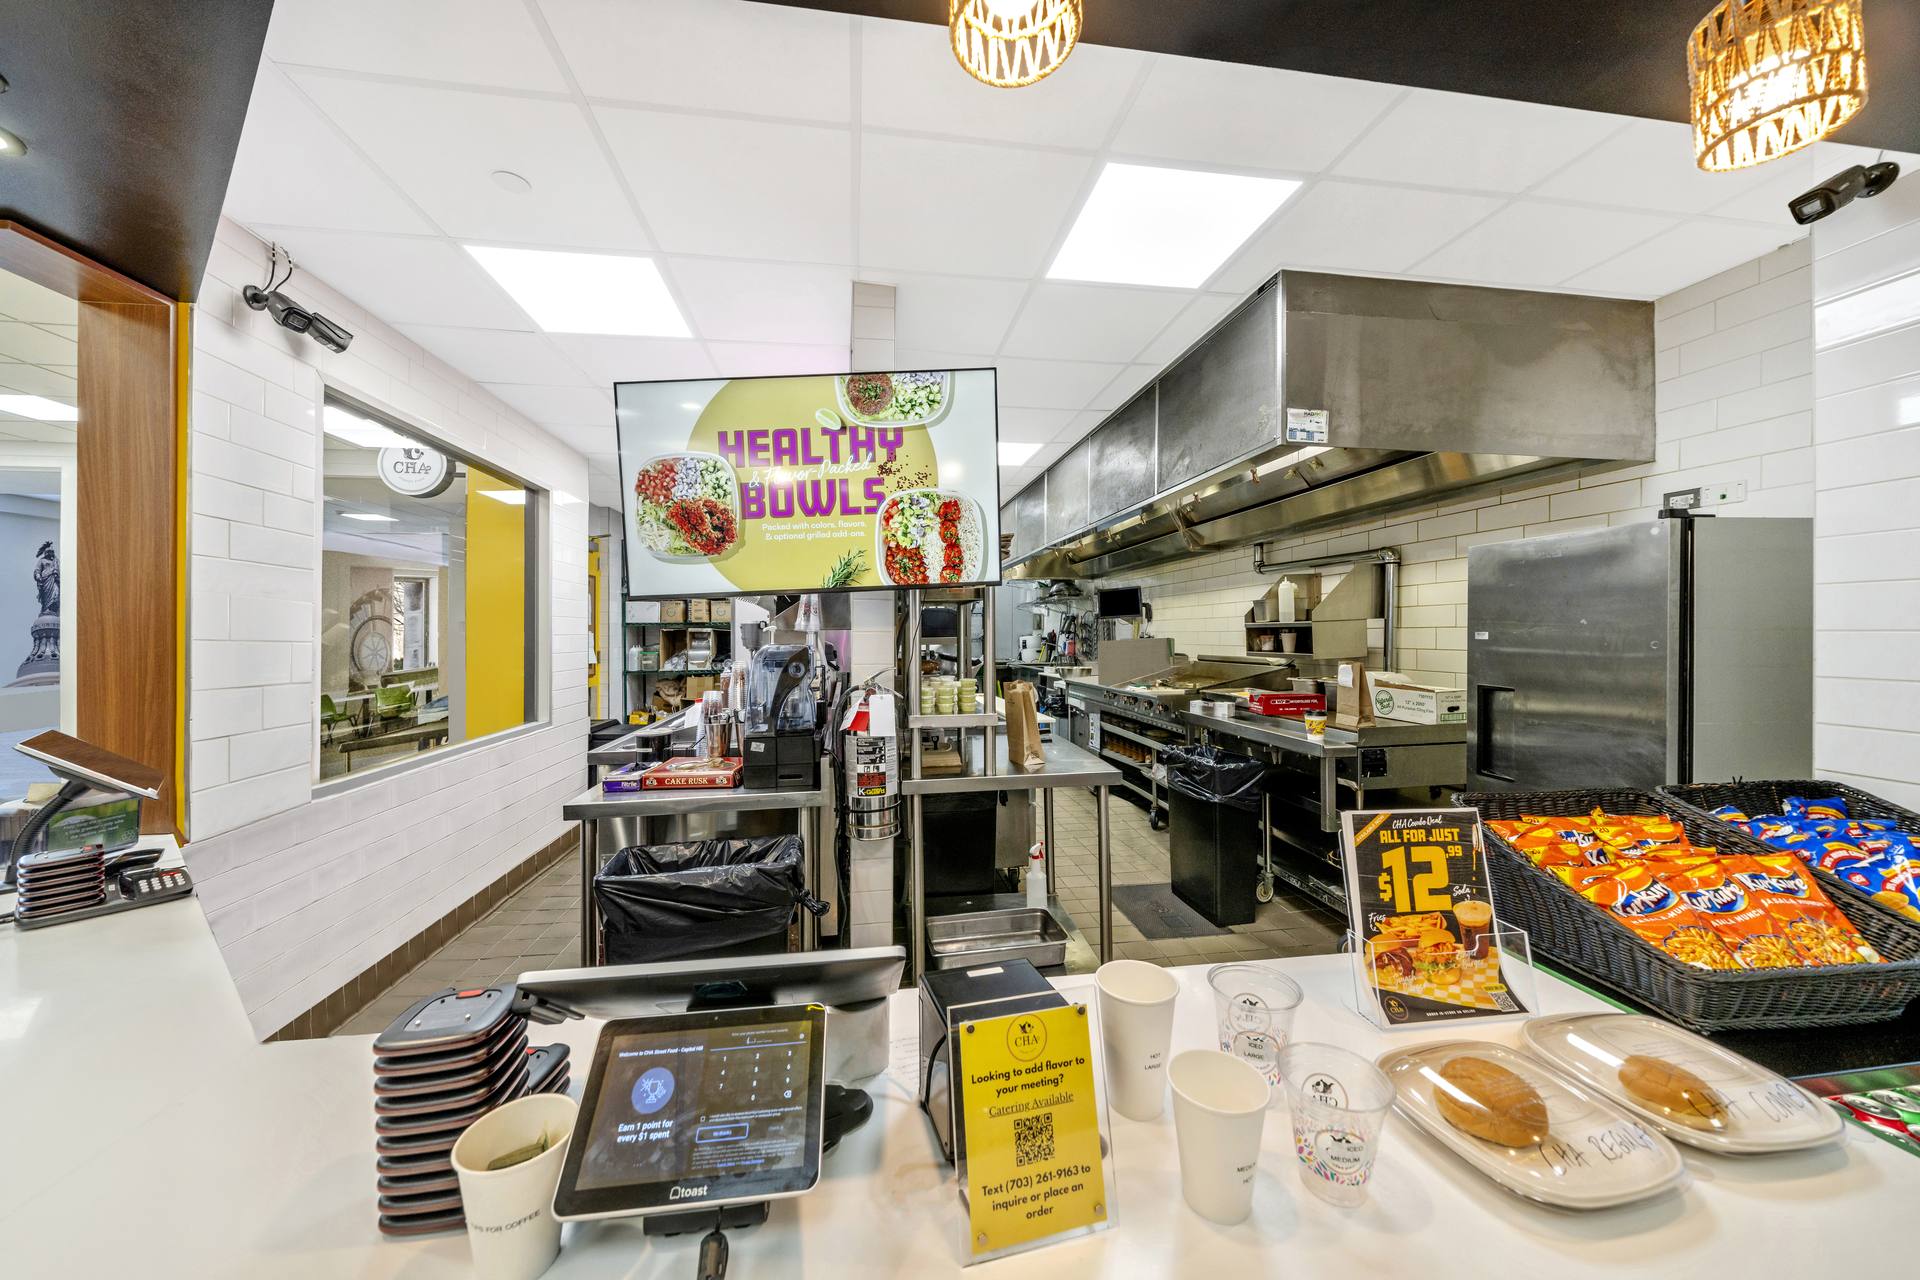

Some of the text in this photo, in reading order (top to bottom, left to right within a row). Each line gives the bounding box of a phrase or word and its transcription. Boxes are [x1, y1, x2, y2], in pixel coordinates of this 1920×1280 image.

[717, 426, 904, 468] HEALTHY
[393, 461, 425, 474] CHA
[748, 471, 760, 487] &
[740, 477, 887, 519] BOWLS
[762, 523, 791, 531] Packed
[792, 522, 809, 530] with
[774, 532, 806, 541] optional
[807, 531, 831, 541] grilled
[664, 777, 687, 785] CAKE
[688, 776, 708, 785] RUSK
[1380, 828, 1460, 844] ALL FOR JUST
[1453, 884, 1471, 897] Soda
[1733, 872, 1808, 895] Kurkure
[1667, 903, 1689, 919] MUN
[1736, 908, 1766, 924] MUNCH
[1014, 1034, 1038, 1048] CHA
[971, 1057, 1085, 1084] Looking to add flavor to
[996, 1073, 1064, 1098] your meeting?
[988, 1091, 1074, 1117] Catering Available
[618, 1119, 674, 1133] Earn 1 point for
[617, 1130, 670, 1143] every $1 spent
[1331, 1155, 1360, 1163] MEDIUM
[981, 1164, 1091, 1196] Text (703) 261-9163 to
[681, 1184, 708, 1198] toast
[992, 1183, 1084, 1211] inquire or place an
[505, 1208, 541, 1230] COFFEE
[1026, 1205, 1054, 1219] order
